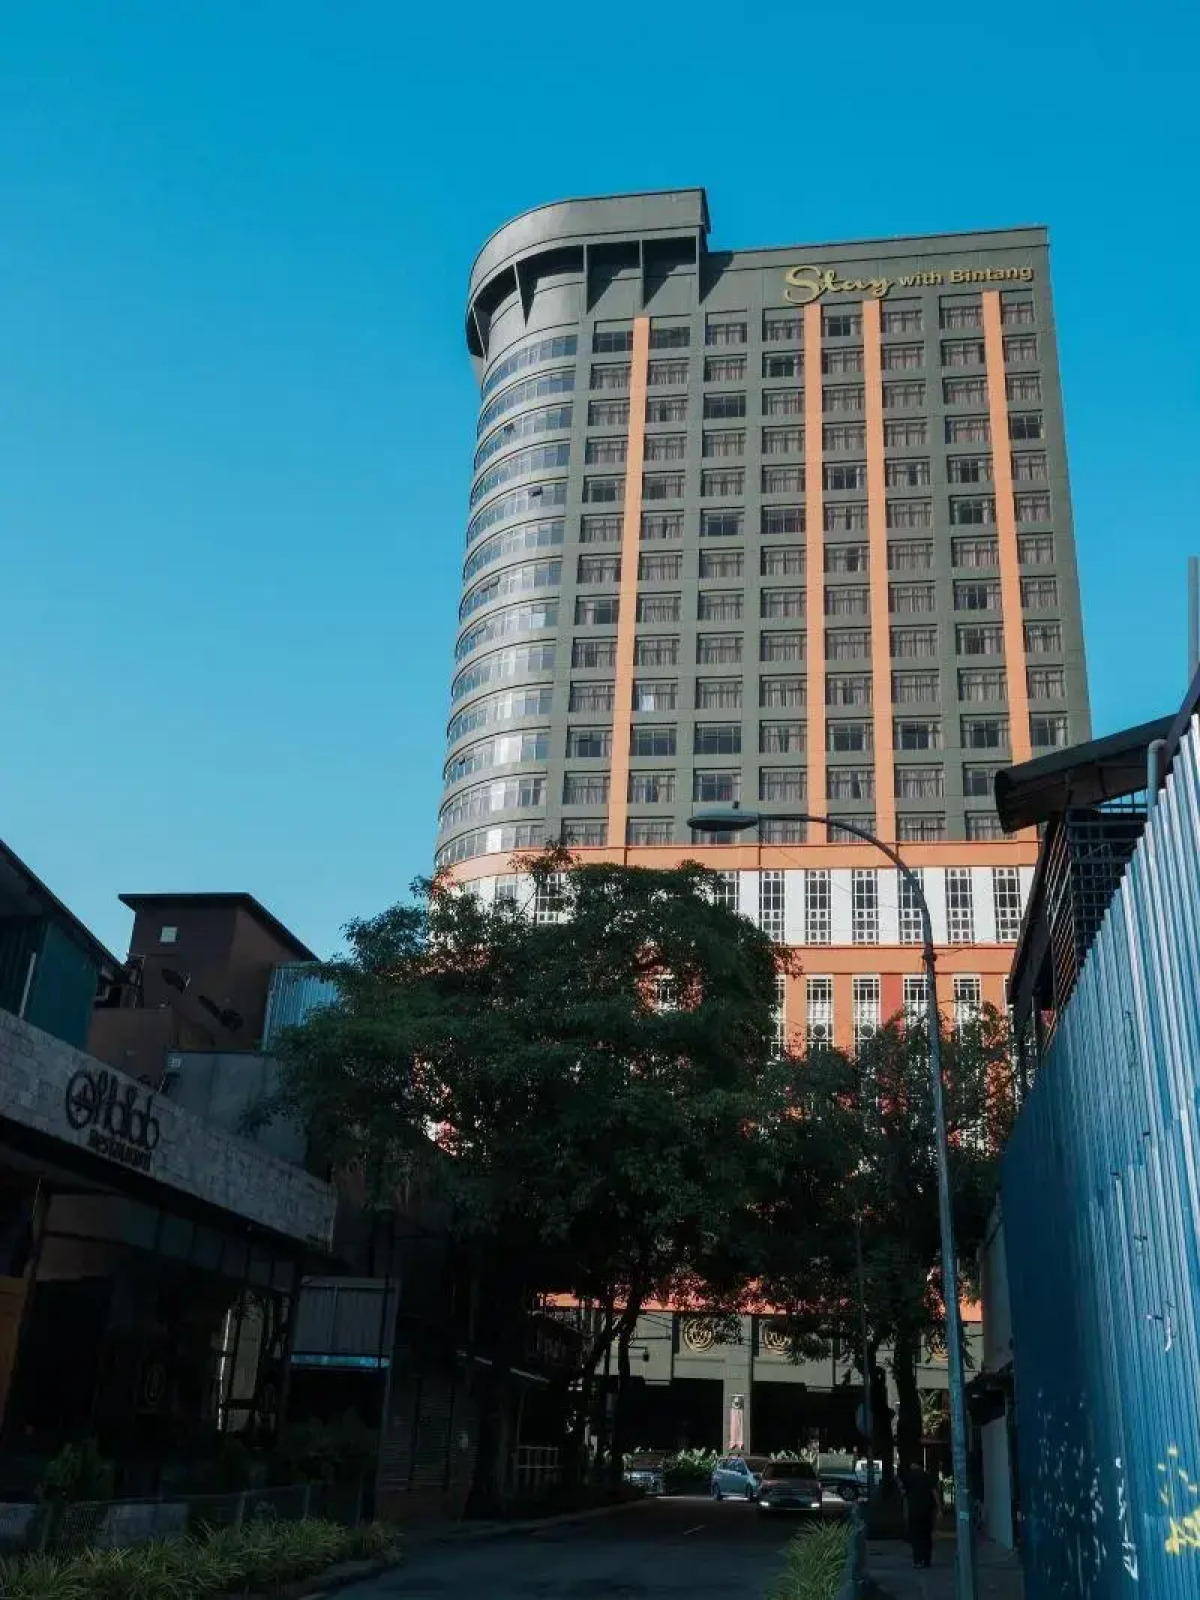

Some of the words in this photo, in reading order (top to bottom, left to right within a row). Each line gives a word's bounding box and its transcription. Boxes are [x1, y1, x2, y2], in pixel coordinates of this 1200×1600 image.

[785, 264, 896, 304] Stay
[899, 271, 943, 286] with
[949, 266, 1034, 284] Bintang
